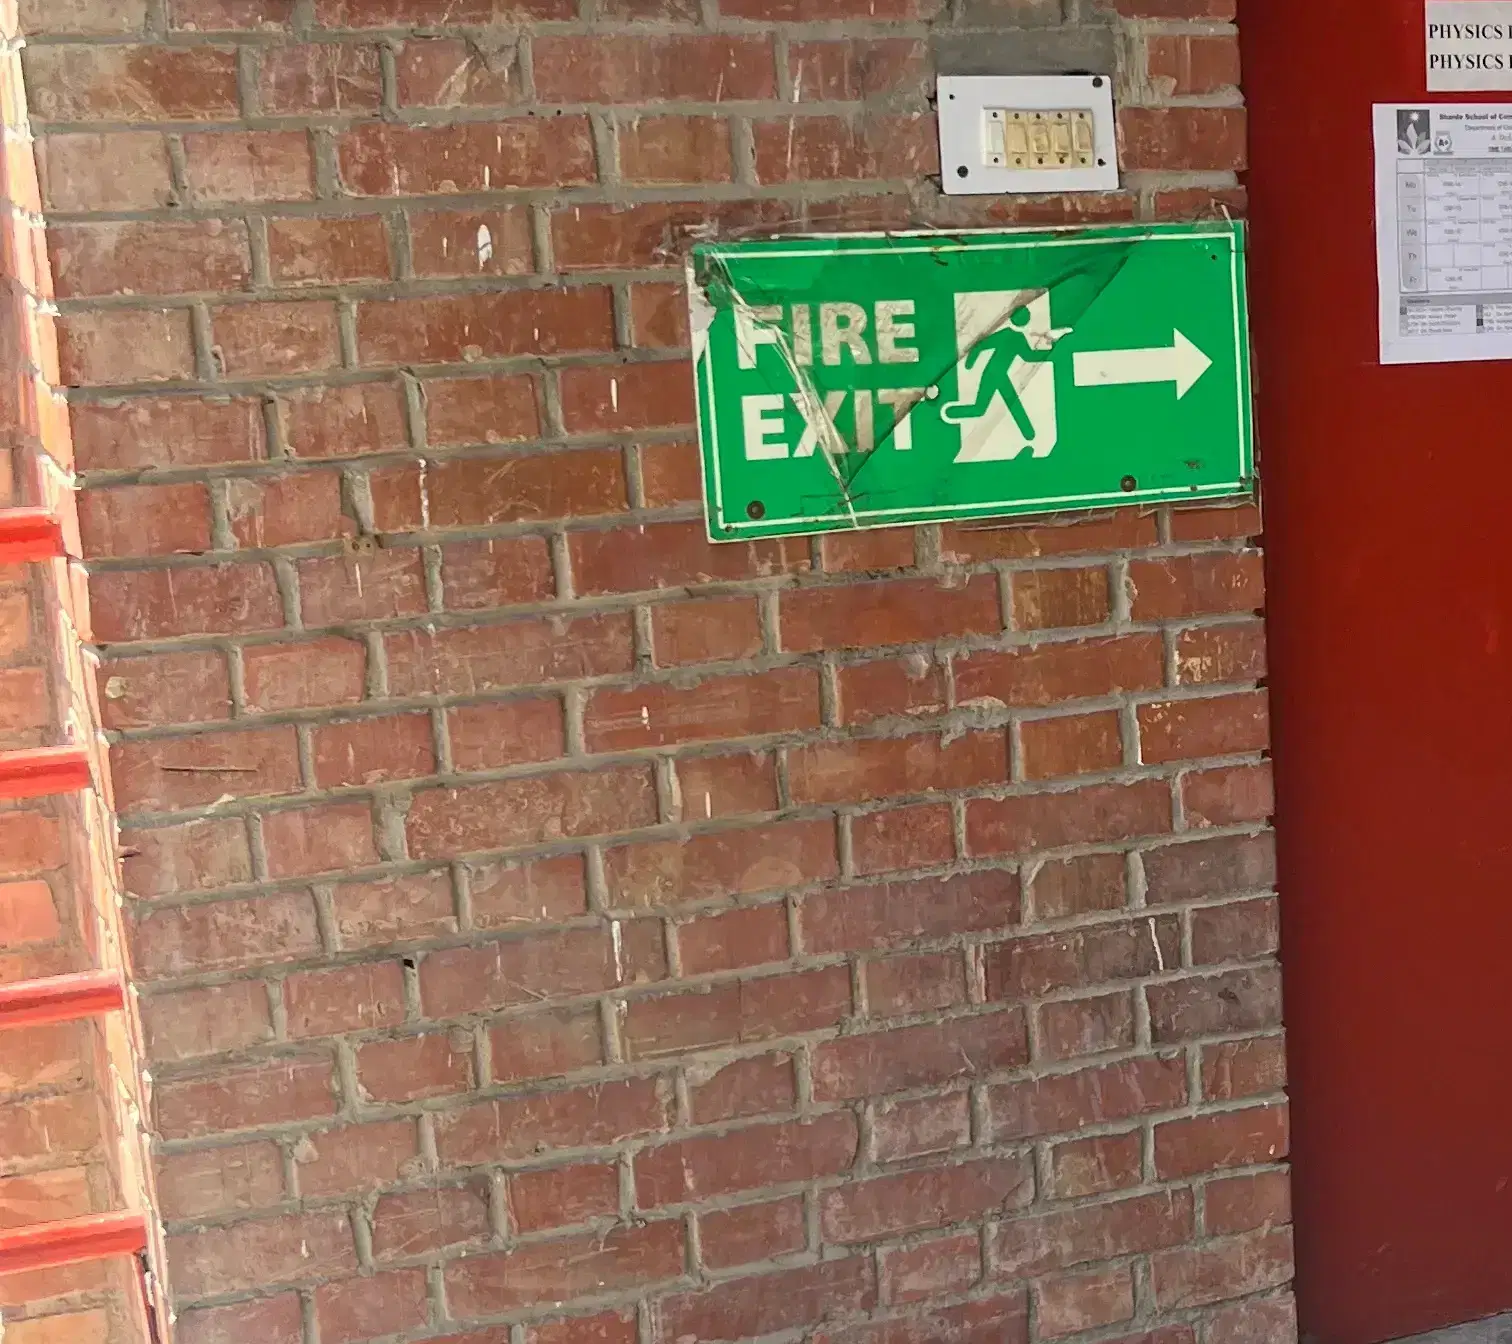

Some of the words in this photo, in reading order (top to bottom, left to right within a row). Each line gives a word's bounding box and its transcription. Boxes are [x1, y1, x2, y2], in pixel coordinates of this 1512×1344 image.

[1429, 23, 1503, 40] PHYSICS
[1429, 54, 1504, 70] PHYSICS
[732, 299, 921, 370] FIRE
[740, 385, 925, 461] EXIT
